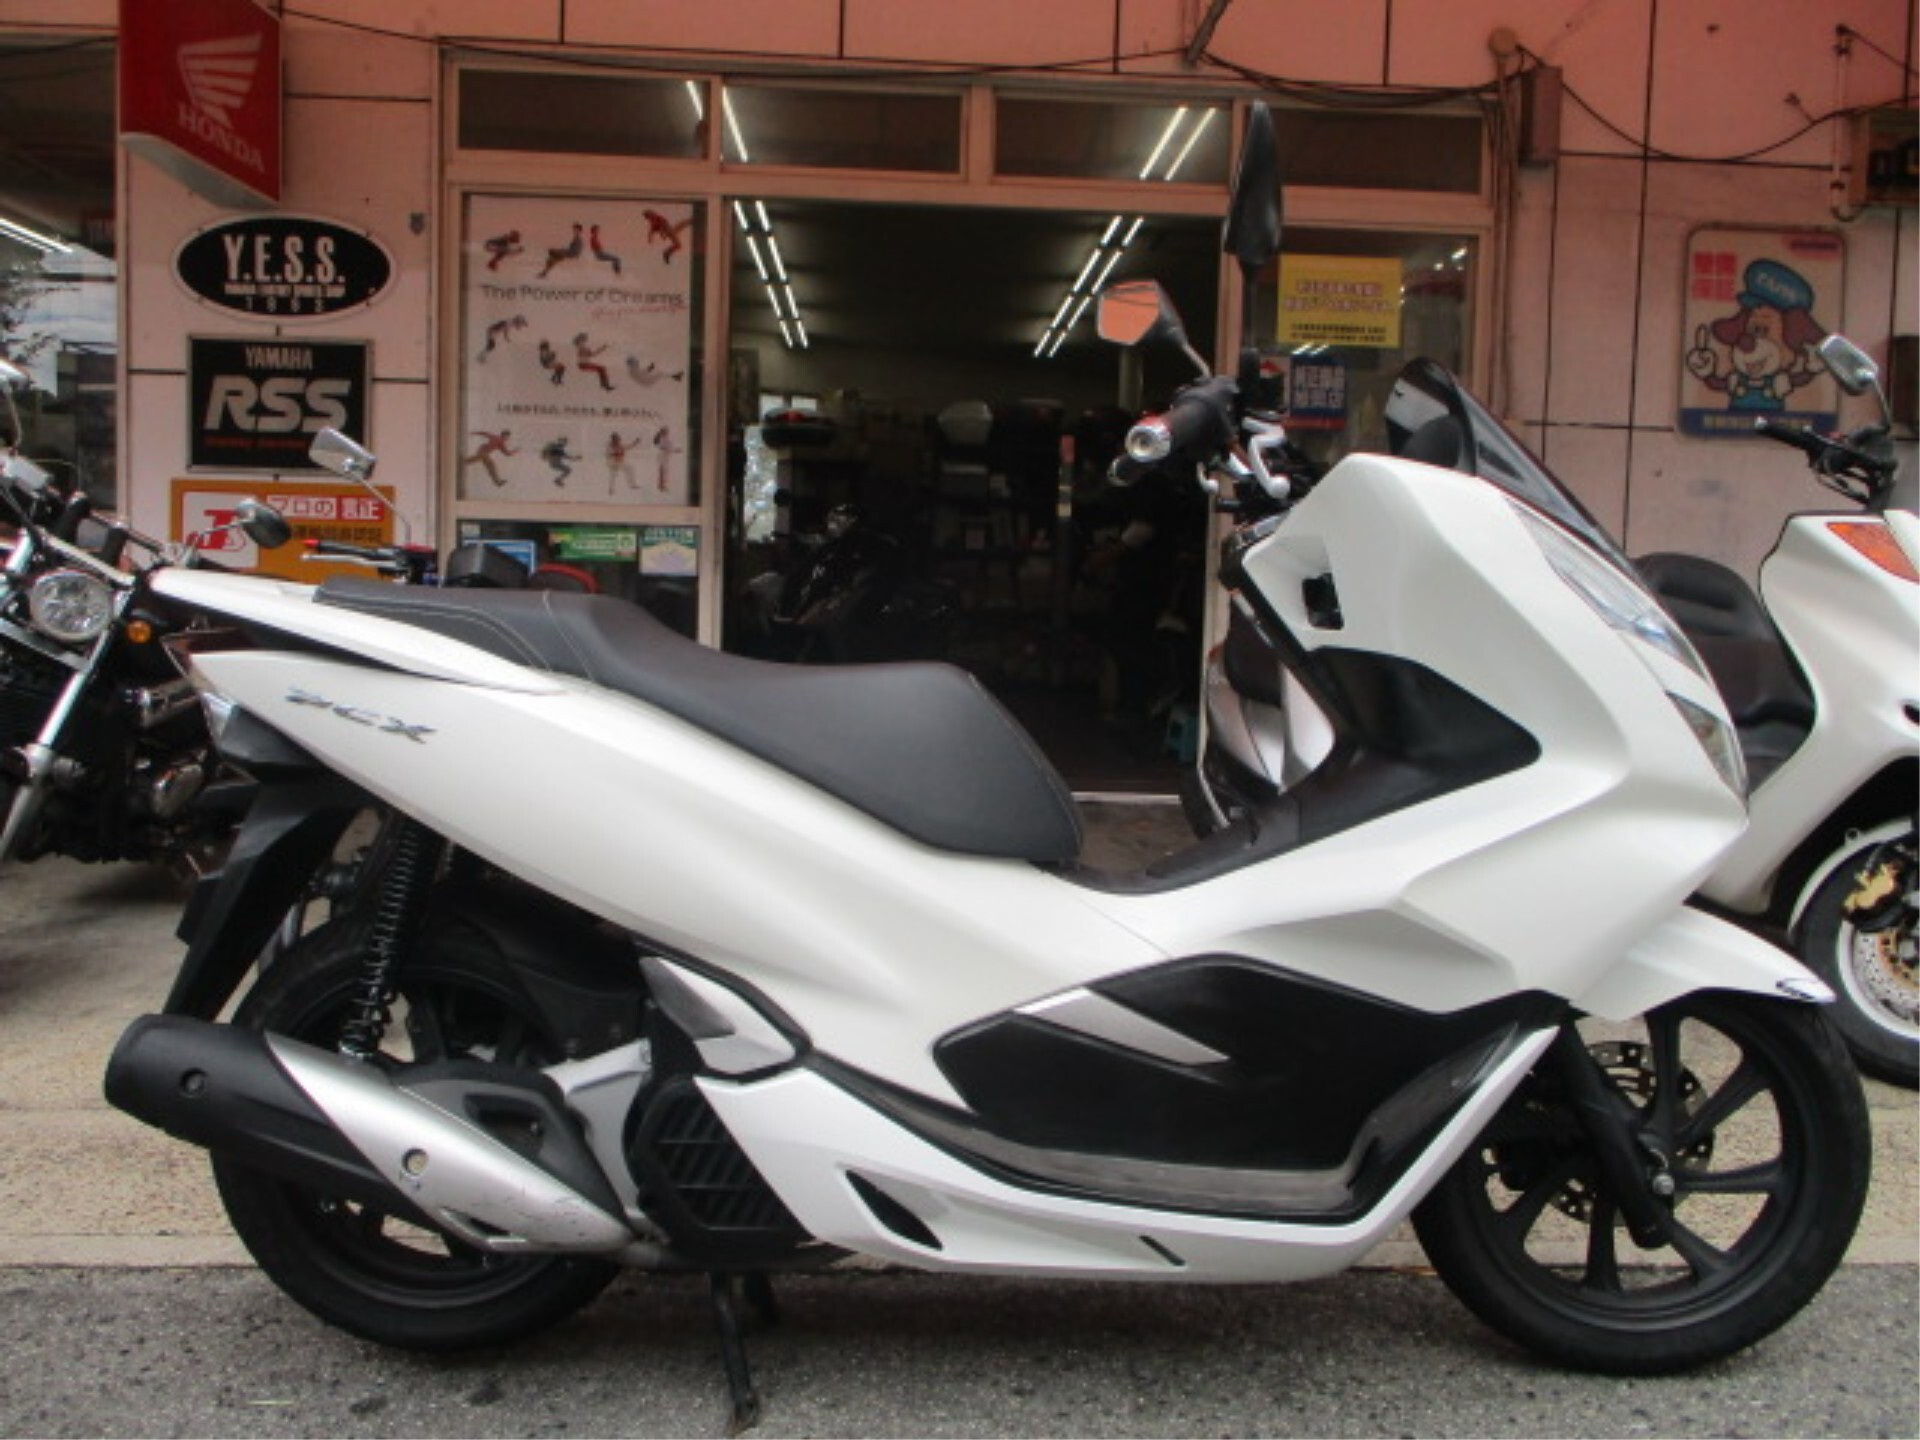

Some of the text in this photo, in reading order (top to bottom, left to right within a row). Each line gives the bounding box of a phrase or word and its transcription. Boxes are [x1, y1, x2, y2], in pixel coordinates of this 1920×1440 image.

[178, 105, 264, 174] HONDA
[224, 234, 346, 283] Y.E.S.S.
[480, 284, 683, 306] The Power of Dreams
[246, 347, 313, 370] YAMAHA
[203, 374, 352, 432] RSS
